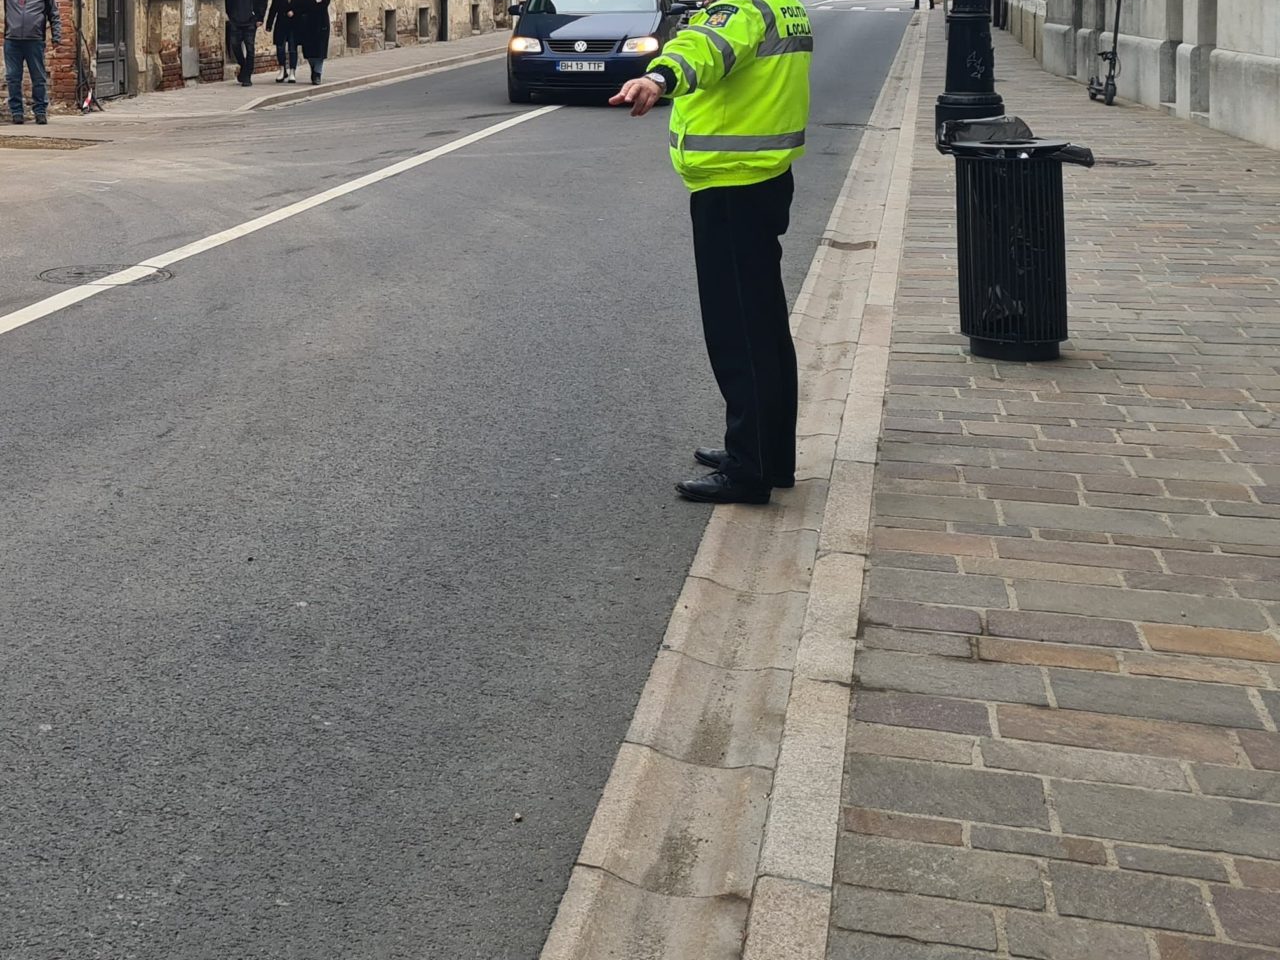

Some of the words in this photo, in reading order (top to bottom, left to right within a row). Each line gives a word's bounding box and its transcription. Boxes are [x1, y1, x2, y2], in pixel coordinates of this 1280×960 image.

[560, 62, 573, 71] BH
[576, 62, 584, 71] 13
[587, 62, 604, 71] TTF
